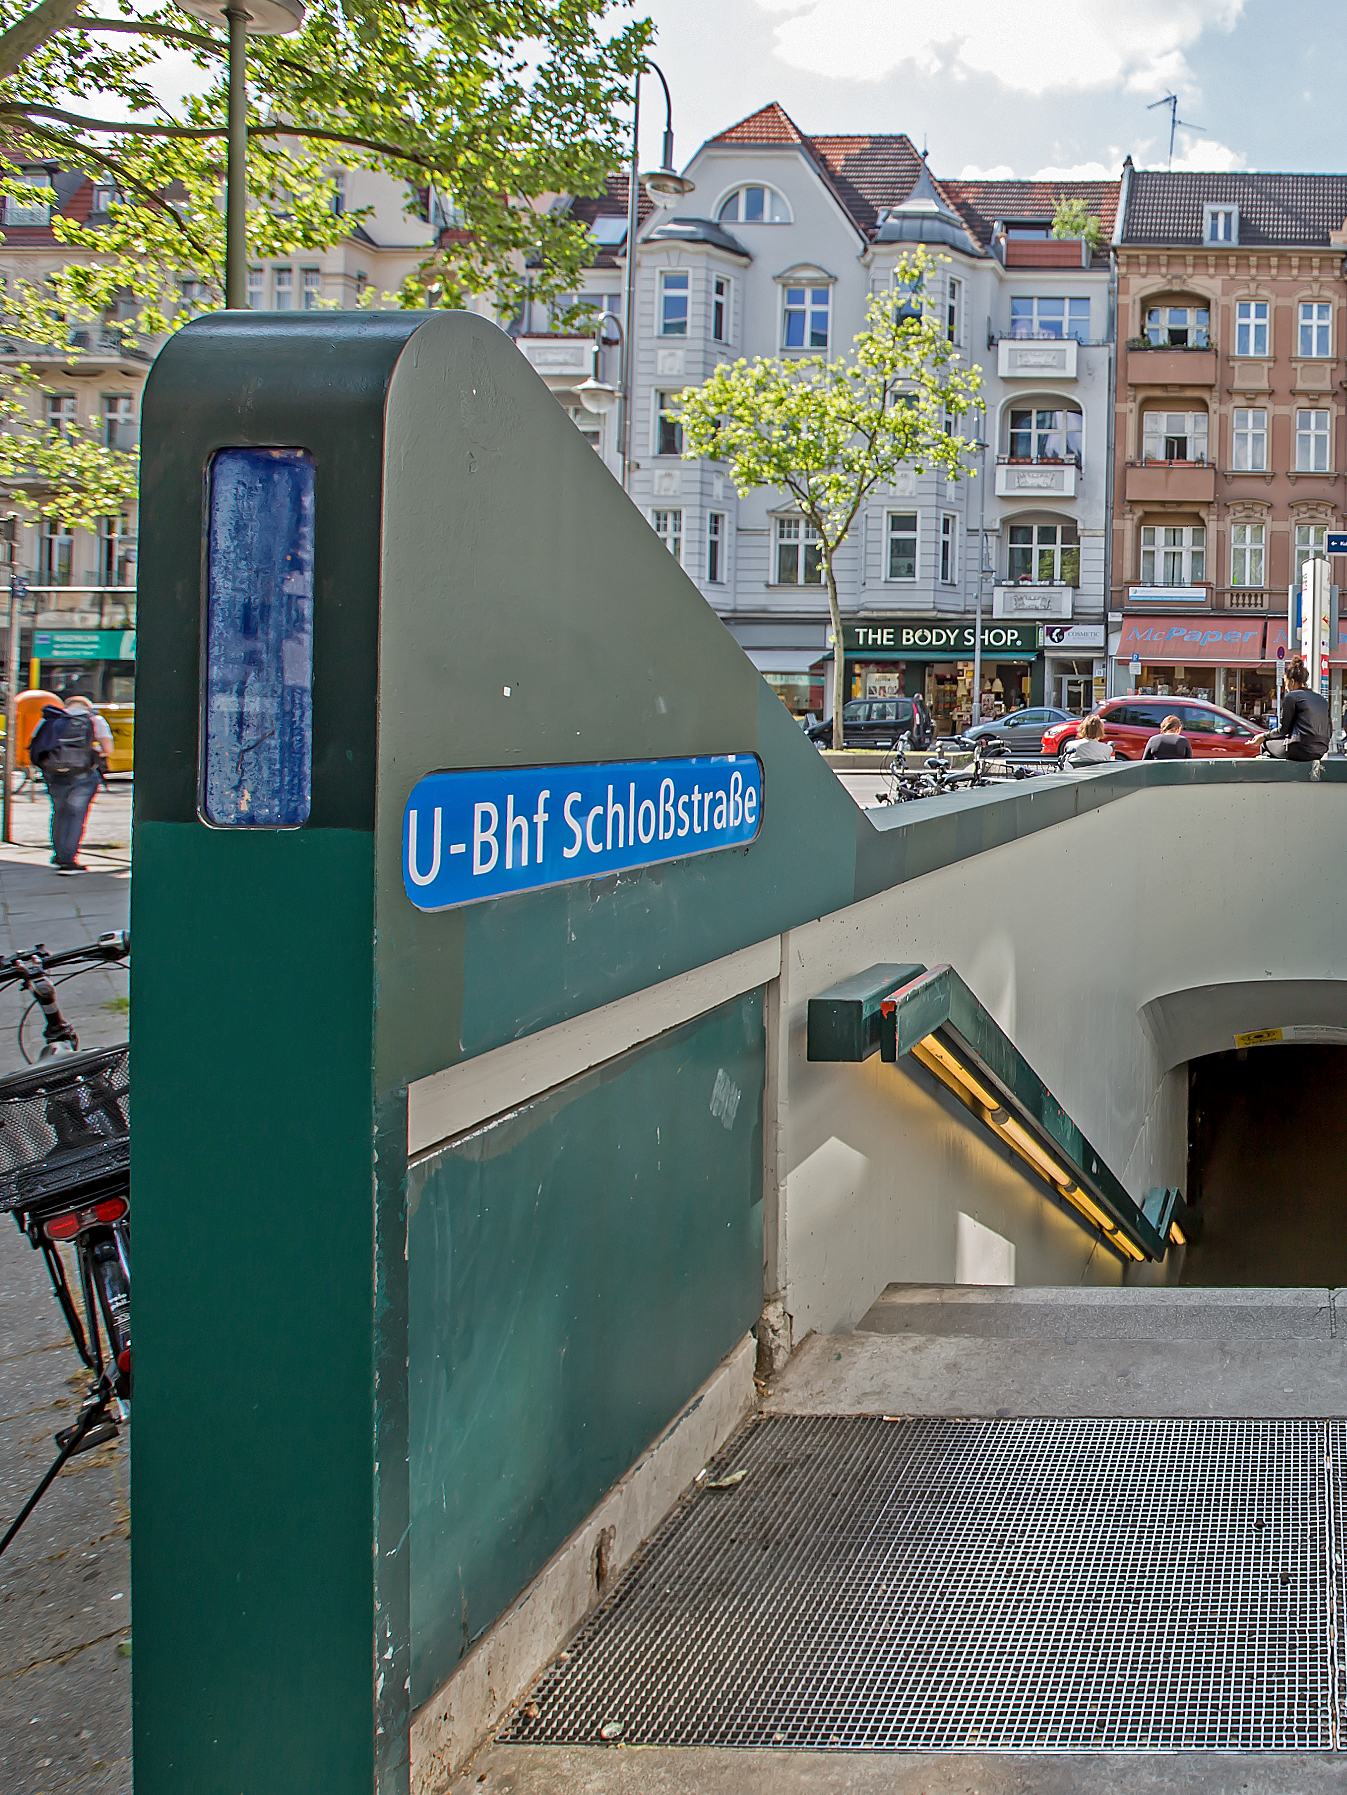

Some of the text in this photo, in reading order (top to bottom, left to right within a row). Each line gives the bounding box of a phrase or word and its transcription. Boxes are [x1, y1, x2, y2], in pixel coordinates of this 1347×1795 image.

[855, 628, 895, 646] THE
[902, 628, 960, 646] BODY
[1126, 627, 1258, 646] McPaper
[408, 770, 756, 886] U-Bhf Schloßstraße
